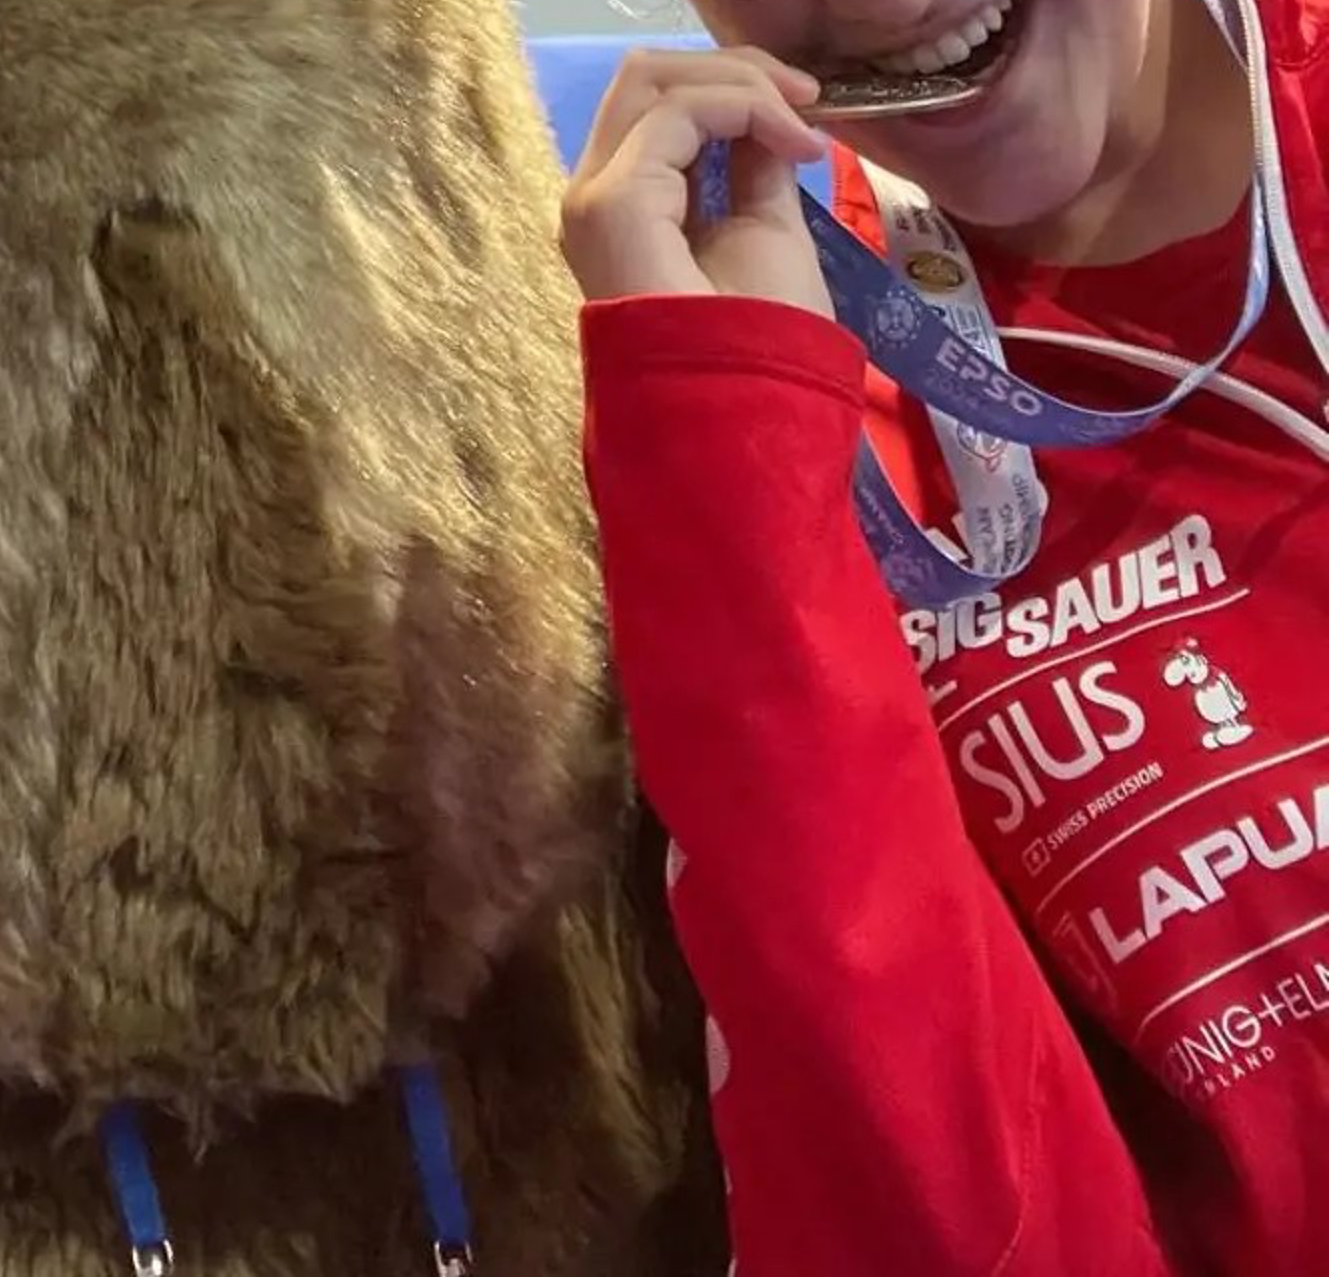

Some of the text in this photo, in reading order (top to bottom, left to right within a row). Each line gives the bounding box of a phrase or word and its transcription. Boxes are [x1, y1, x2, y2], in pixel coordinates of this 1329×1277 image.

[935, 337, 1044, 417] EPSO
[1005, 513, 1227, 659] SAUER
[960, 660, 1146, 835] SIUS
[1046, 761, 1164, 851] SWISS PRECISION
